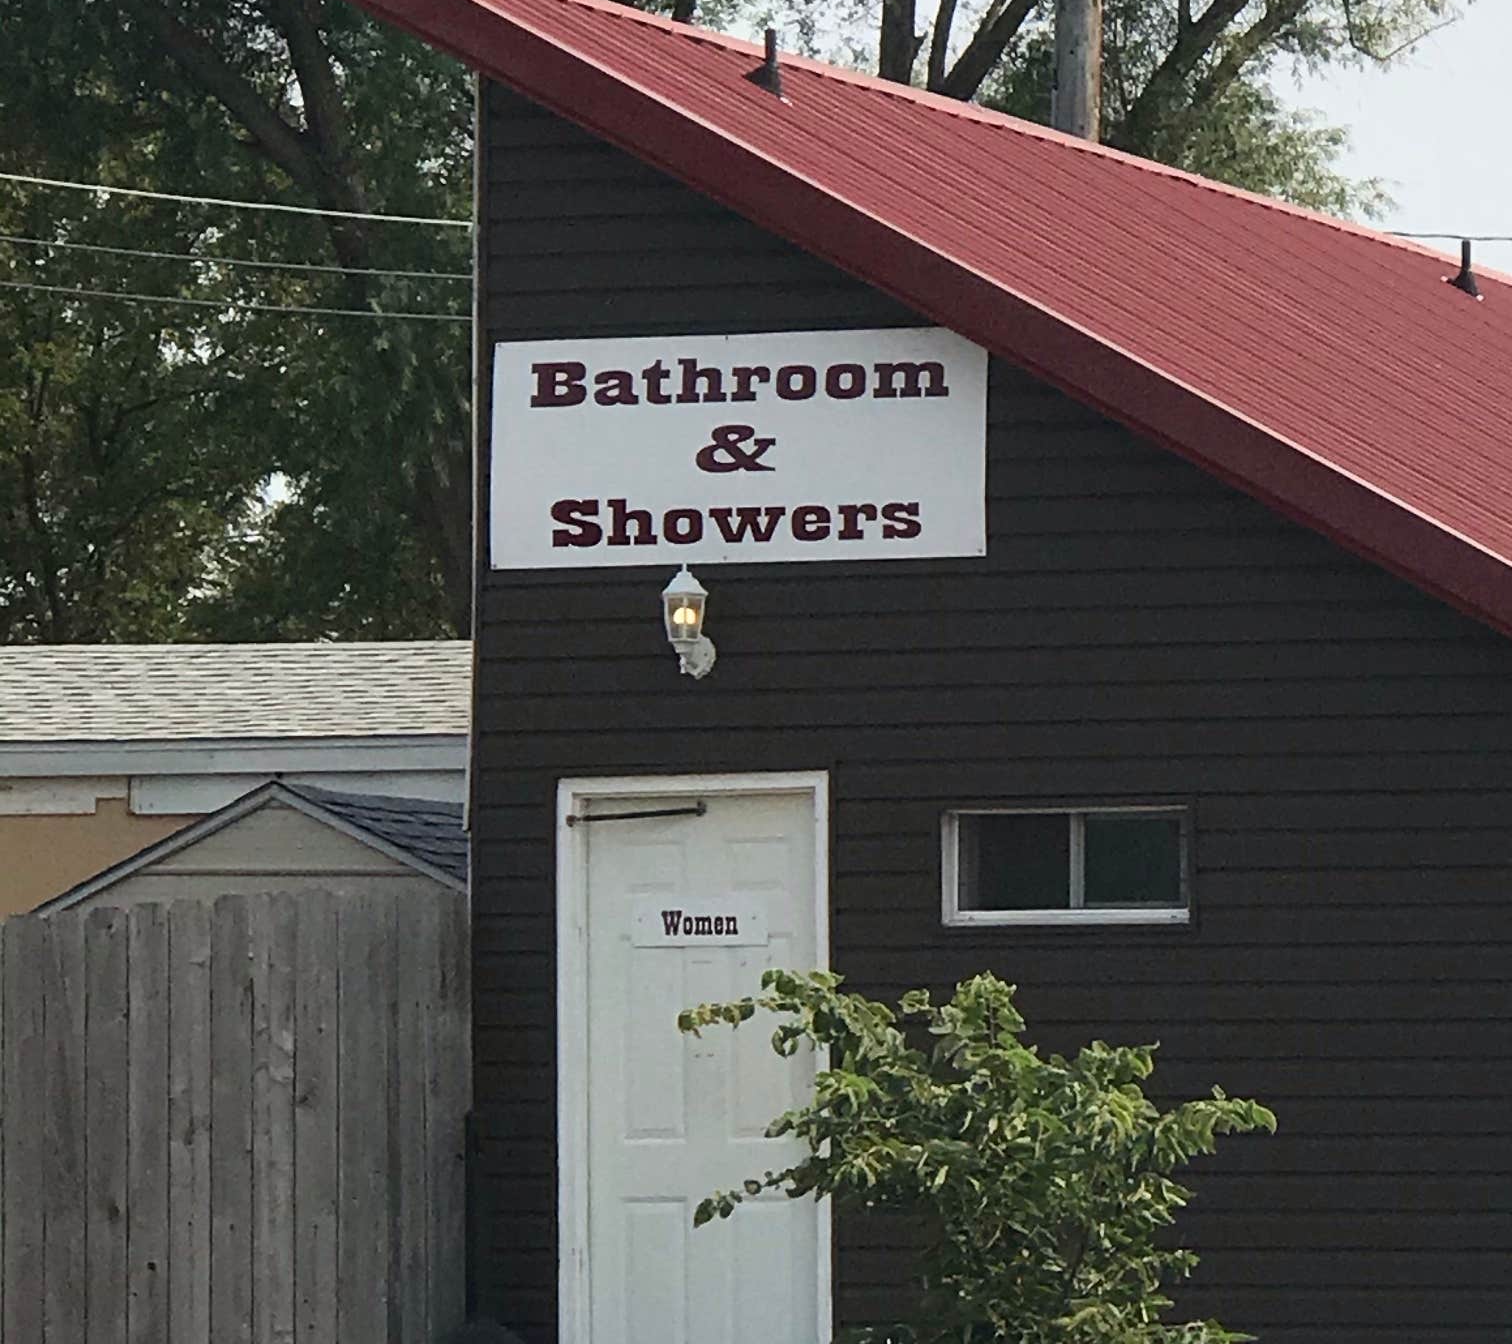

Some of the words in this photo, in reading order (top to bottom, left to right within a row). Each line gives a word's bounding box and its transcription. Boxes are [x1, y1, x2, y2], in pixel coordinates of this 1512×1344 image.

[529, 357, 951, 409] Bathroom
[695, 424, 777, 474] &
[550, 498, 923, 548] Showers
[660, 909, 739, 937] Women
